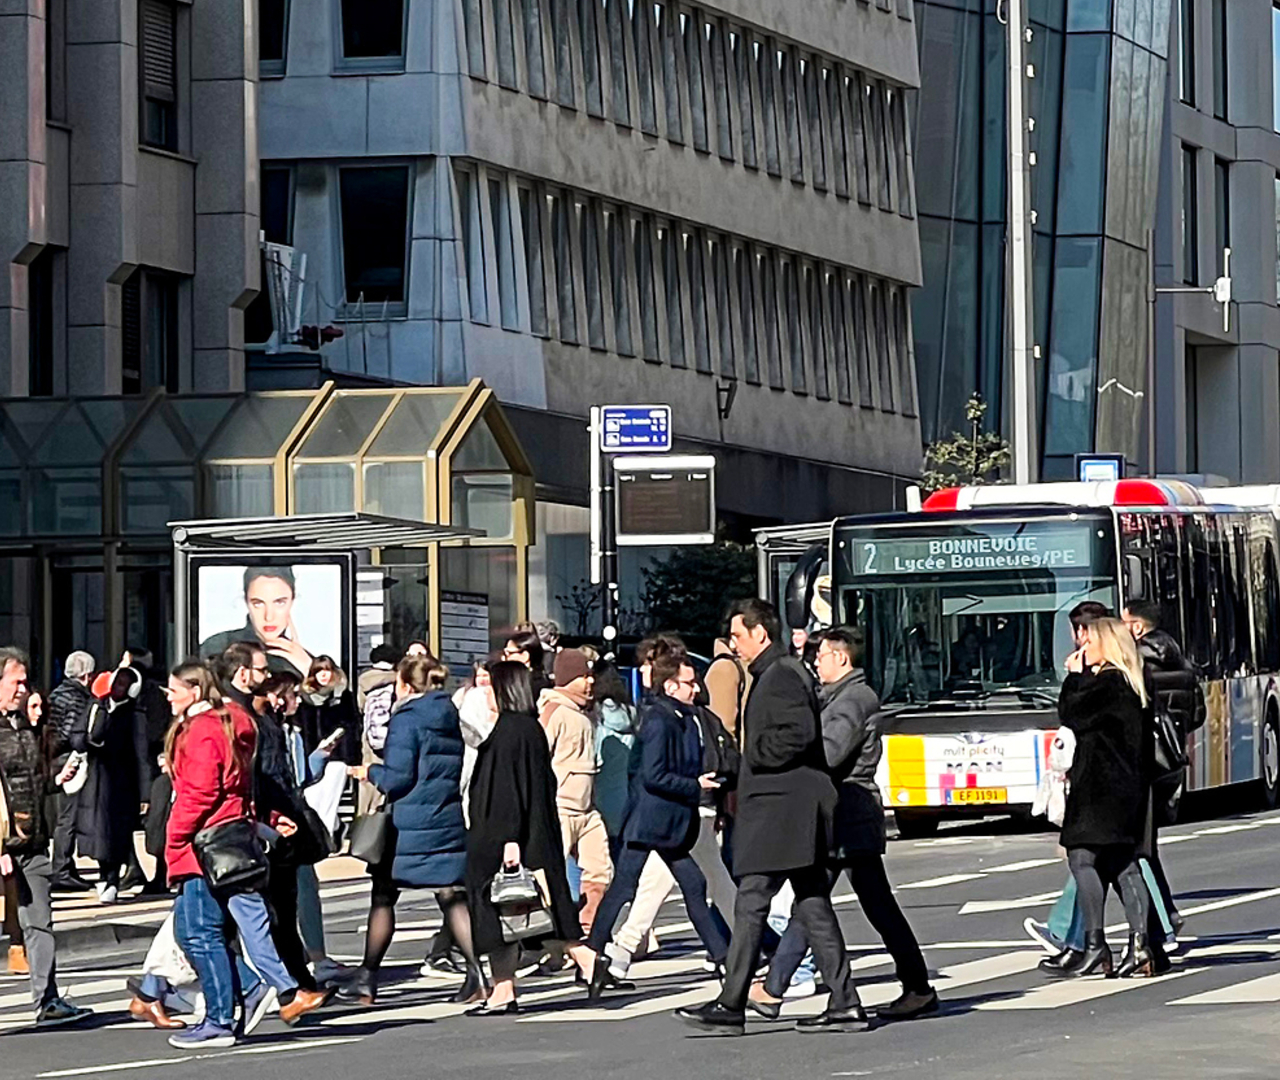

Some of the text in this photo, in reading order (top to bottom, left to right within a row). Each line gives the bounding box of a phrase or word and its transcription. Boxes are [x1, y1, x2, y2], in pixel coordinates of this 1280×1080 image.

[929, 536, 1037, 555] BONNEVOIE
[863, 542, 878, 574] 2
[894, 554, 946, 572] Lycée
[946, 761, 1003, 773] MAN
[959, 791, 972, 801] EF
